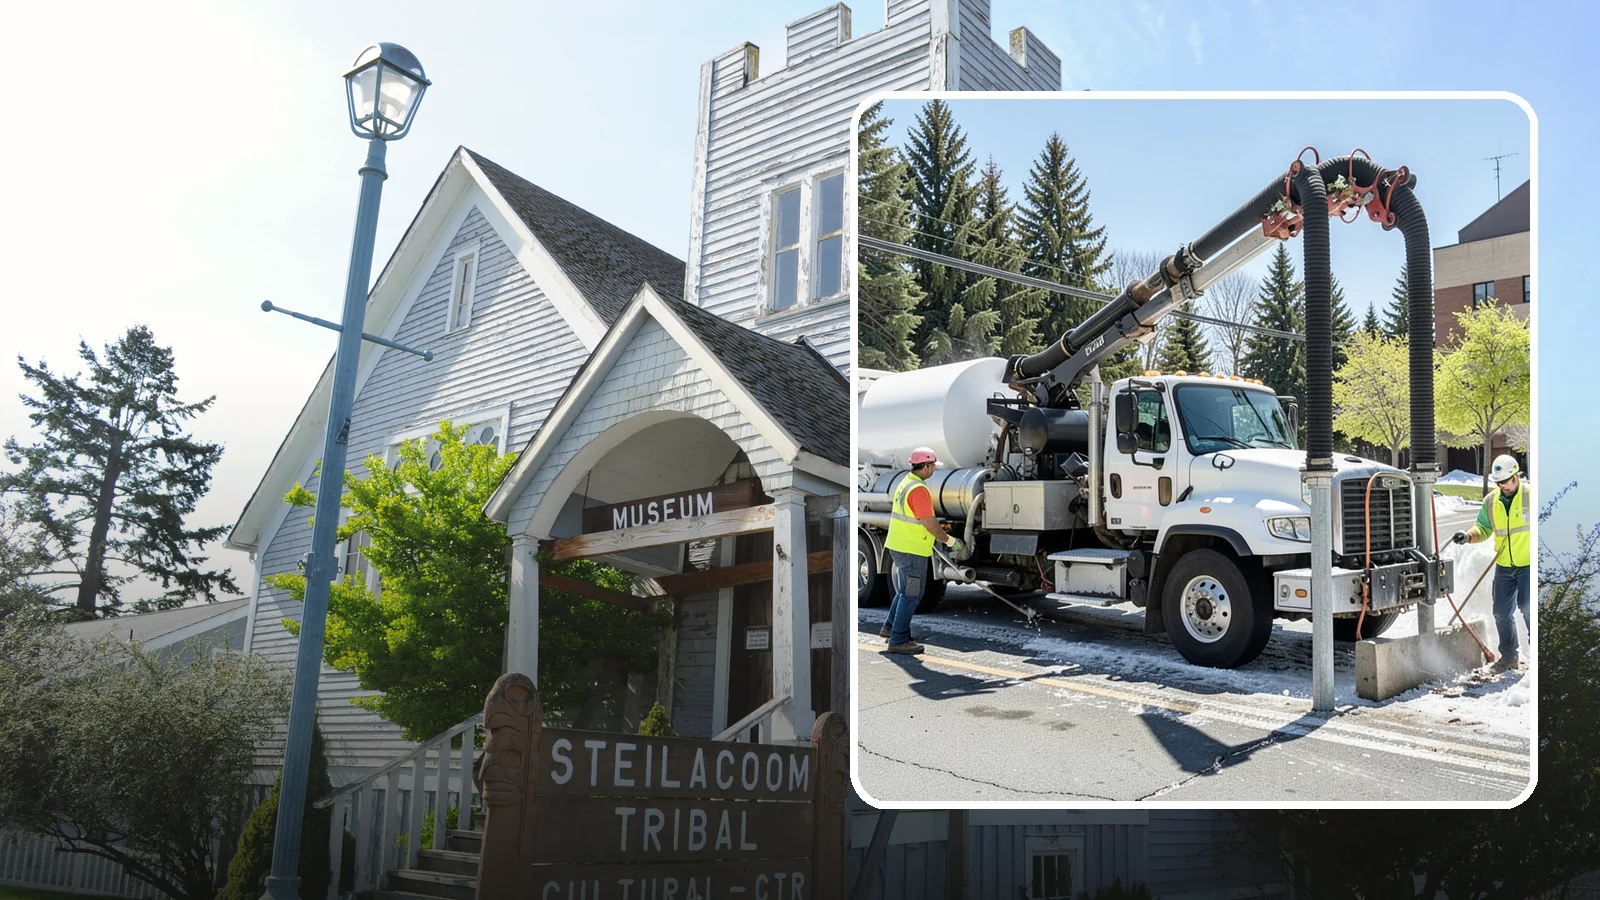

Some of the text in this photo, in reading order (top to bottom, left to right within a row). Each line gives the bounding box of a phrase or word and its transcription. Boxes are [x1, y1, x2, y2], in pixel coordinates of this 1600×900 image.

[612, 491, 714, 531] MUSEUM
[550, 738, 809, 792] STEILACOOM
[615, 806, 757, 852] TRIBAL
